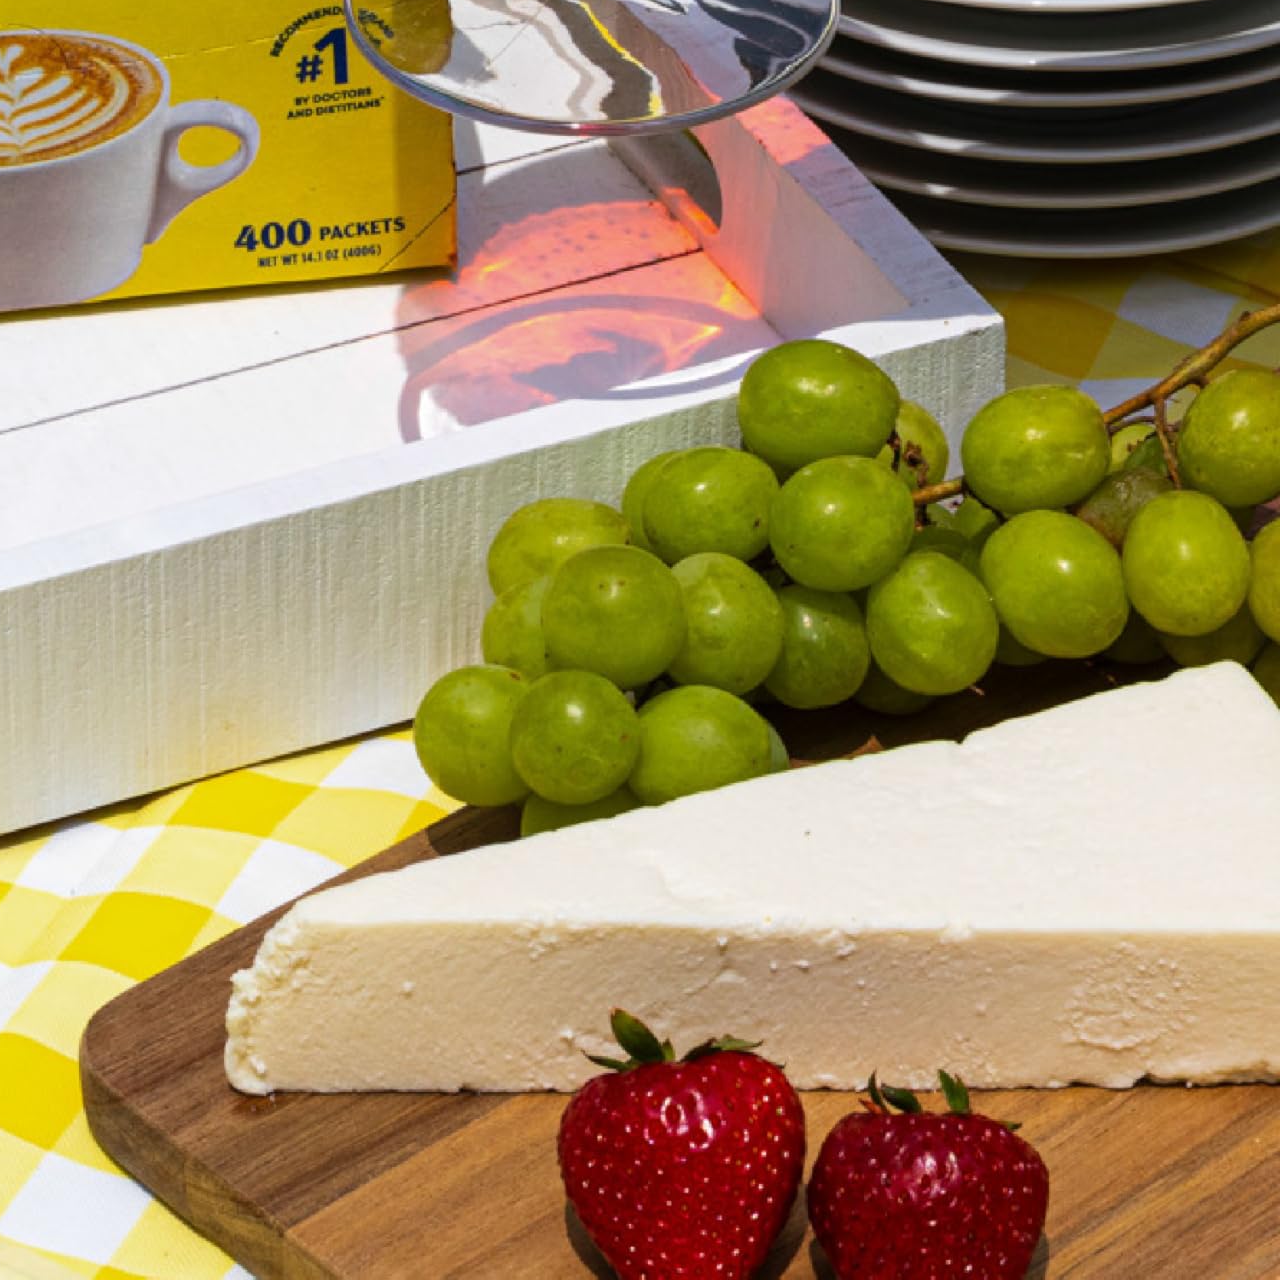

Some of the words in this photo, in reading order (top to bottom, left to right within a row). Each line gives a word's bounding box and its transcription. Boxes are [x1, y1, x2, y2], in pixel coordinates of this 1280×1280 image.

[296, 27, 349, 85] #1
[294, 95, 310, 106] BY
[313, 86, 372, 103] DOCTORS
[287, 108, 313, 119] AND
[234, 218, 312, 253] 400
[320, 216, 407, 241] PACKETS
[257, 256, 277, 268] NET
[282, 253, 298, 266] WT
[325, 248, 339, 262] OZ
